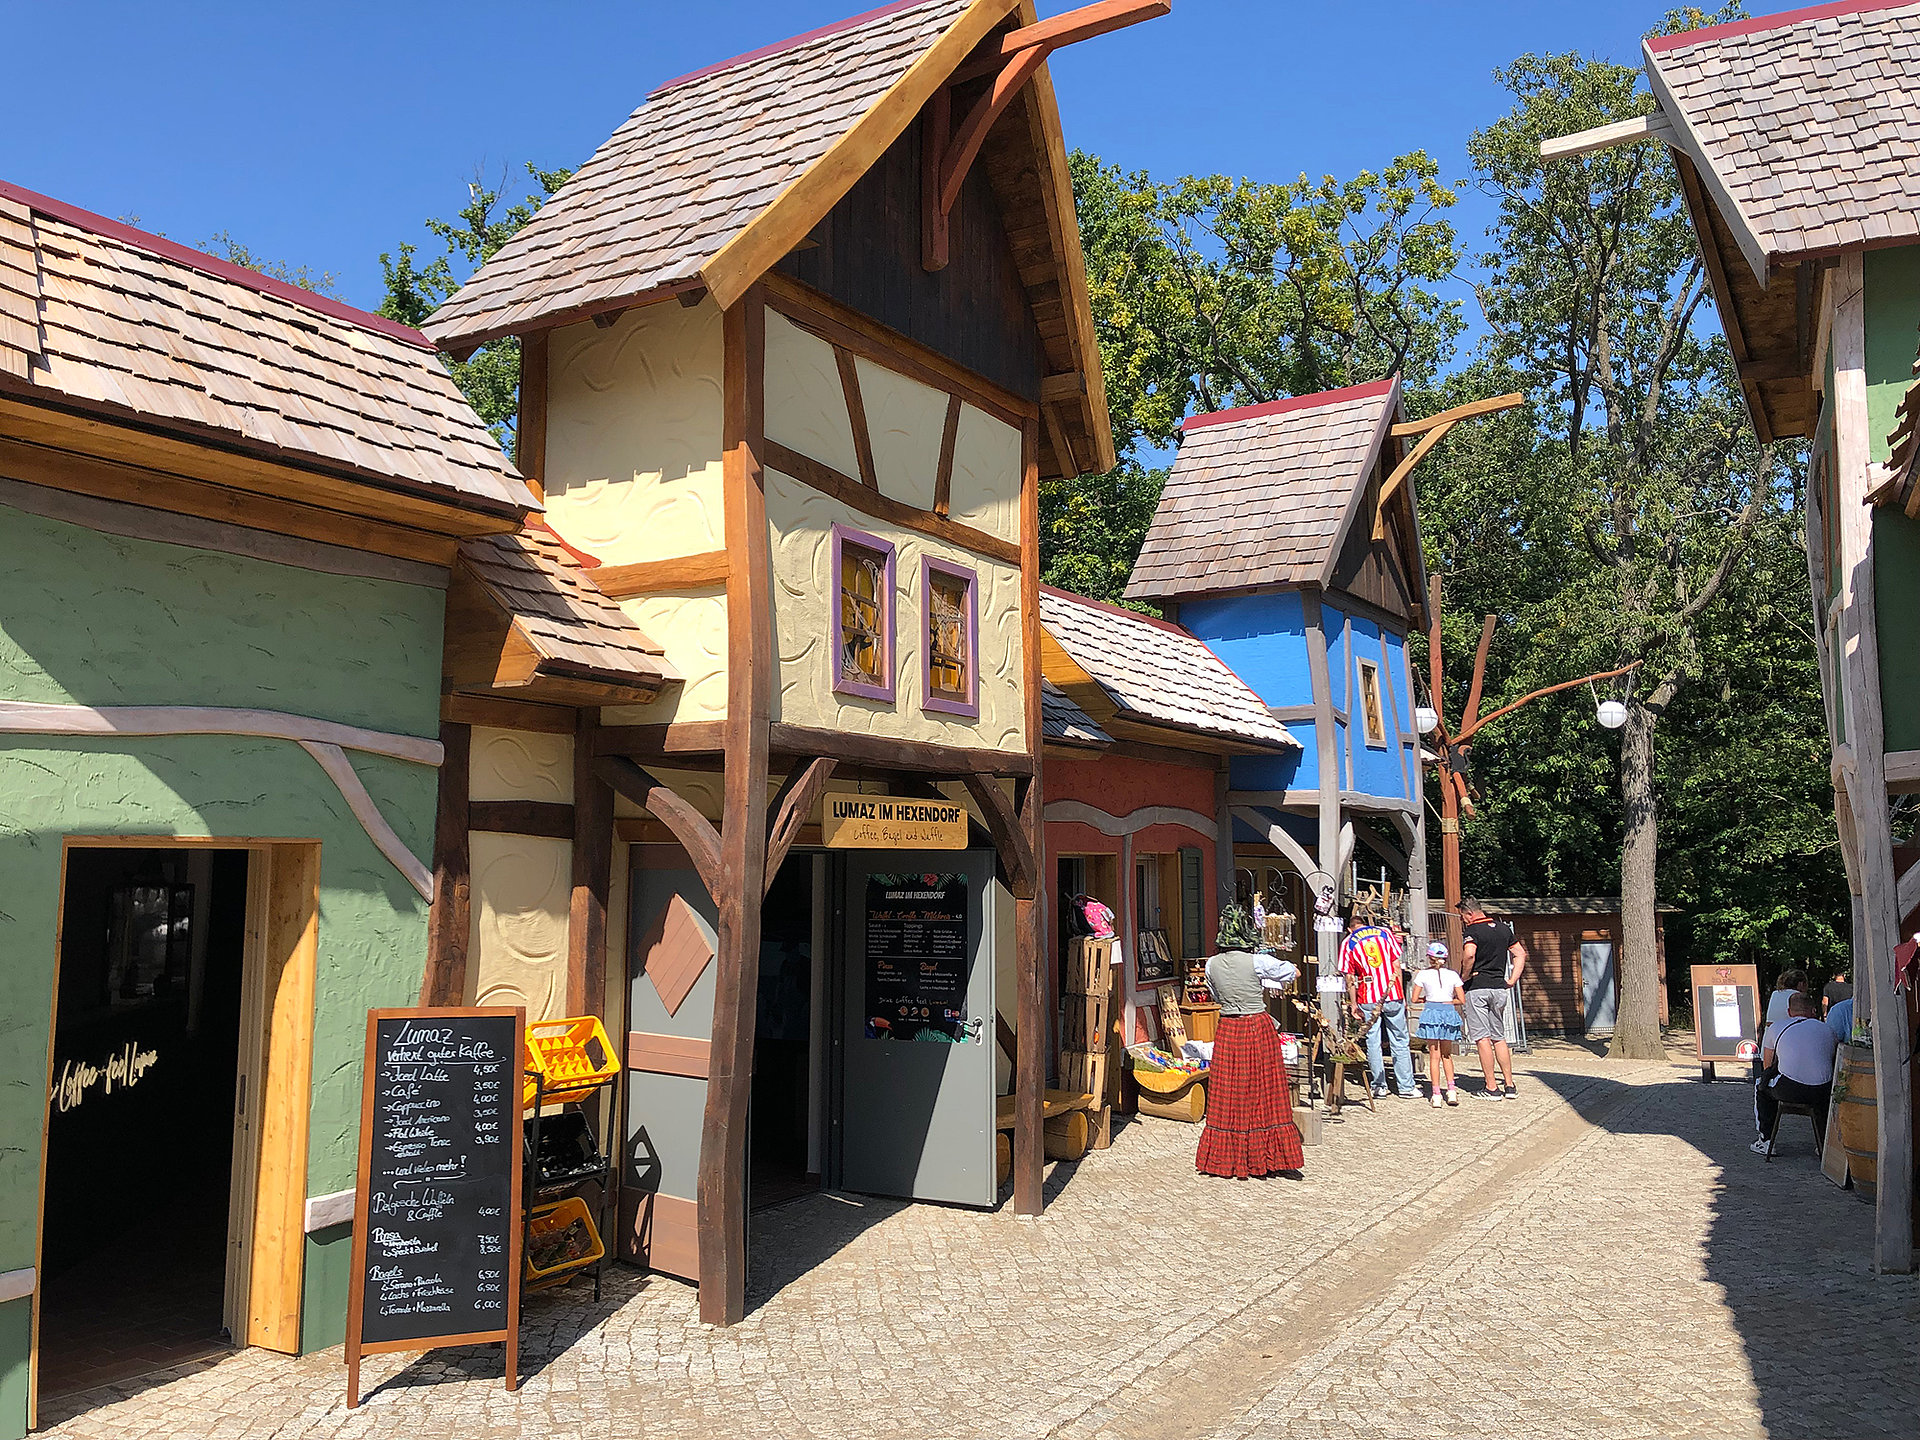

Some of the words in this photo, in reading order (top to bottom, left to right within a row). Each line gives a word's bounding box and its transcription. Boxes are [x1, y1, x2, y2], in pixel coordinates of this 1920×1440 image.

[833, 801, 876, 820] LUMAZ
[879, 803, 893, 820] IM
[896, 804, 961, 823] HEXENDORF
[882, 826, 902, 846] Bagel
[905, 827, 918, 841] and
[1364, 940, 1383, 968] 9
[393, 1020, 455, 1047] Lumaz
[427, 1046, 457, 1064] guter
[420, 1065, 450, 1082] Latte
[473, 1064, 500, 1076] 4,50€
[390, 1083, 422, 1099] Café
[369, 1265, 404, 1284] Bagels
